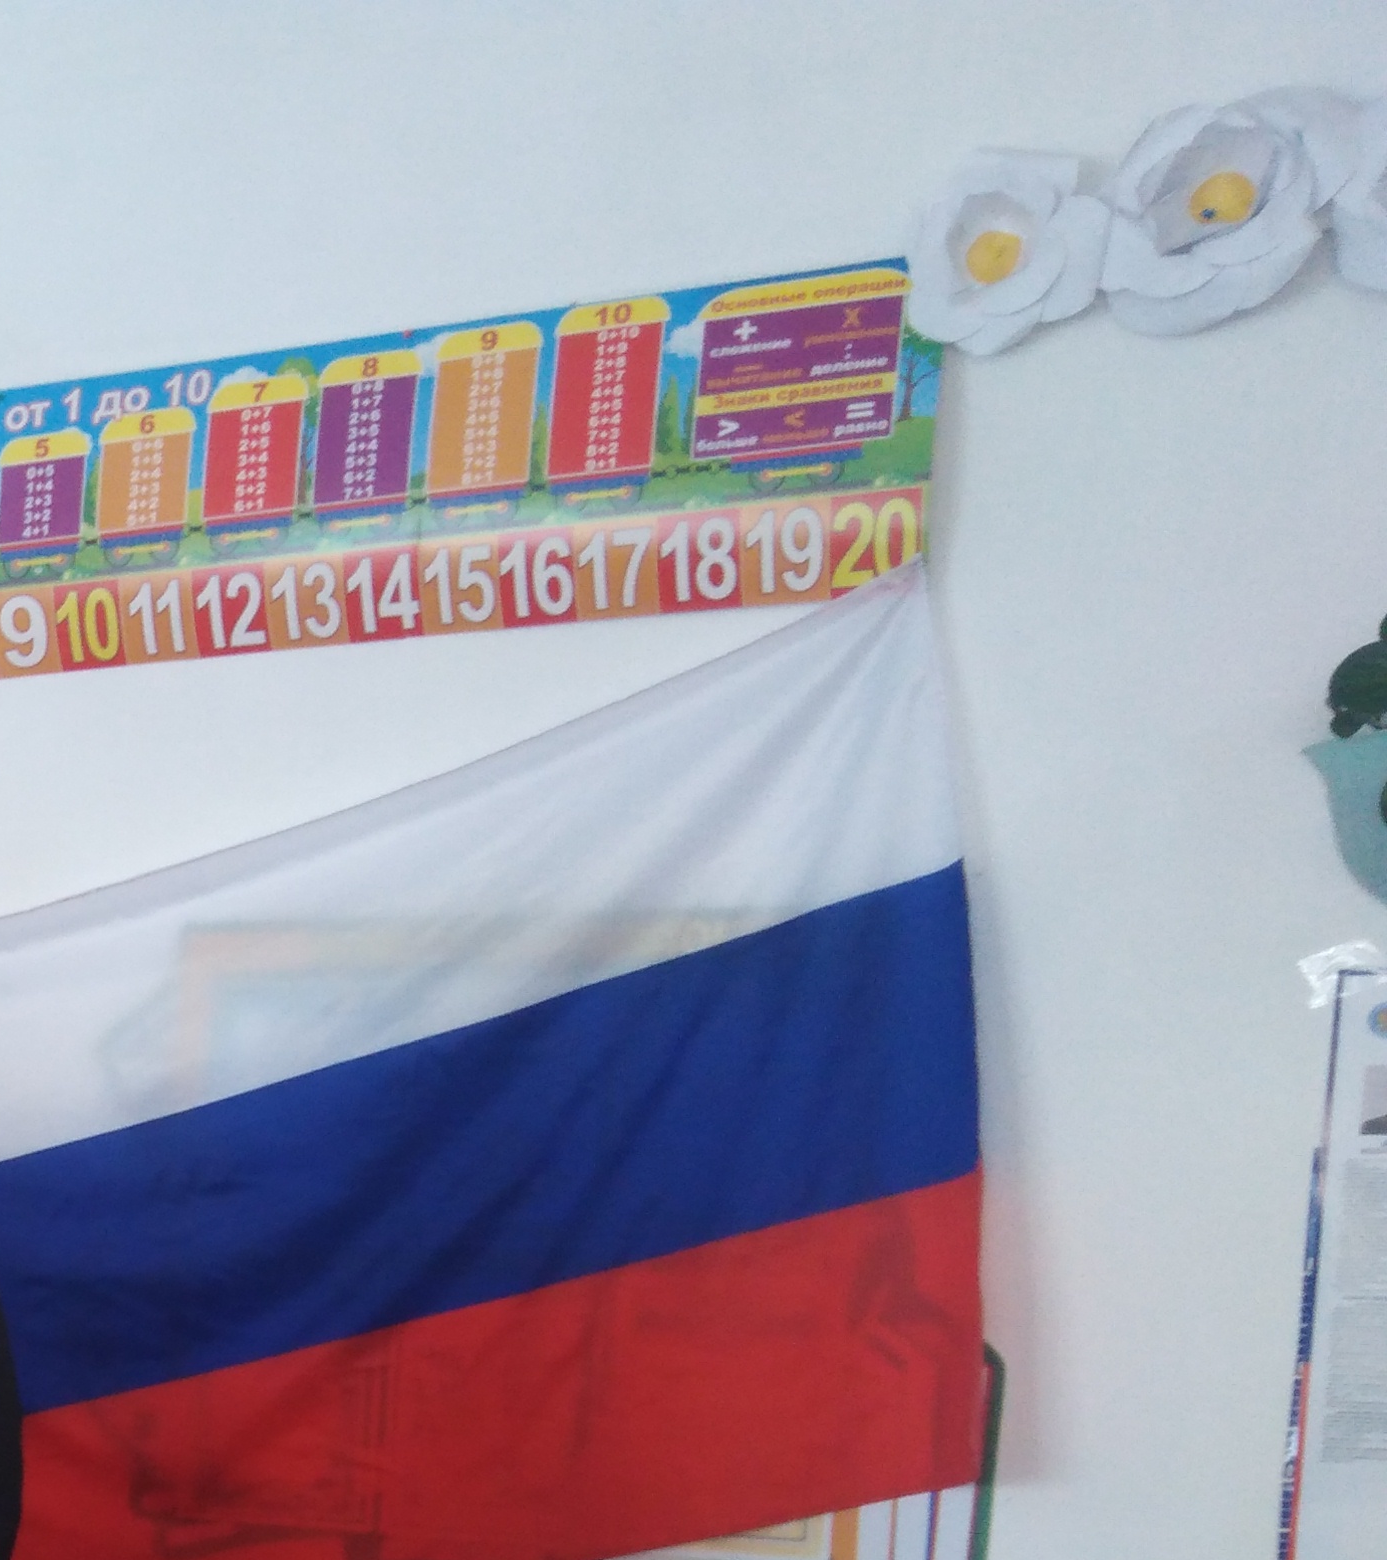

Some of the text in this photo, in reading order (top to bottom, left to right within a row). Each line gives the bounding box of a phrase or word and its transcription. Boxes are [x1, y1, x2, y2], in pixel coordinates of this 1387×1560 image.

[711, 278, 907, 313] Основные операции
[596, 304, 632, 326] 10
[481, 330, 498, 350] 9
[709, 338, 793, 358] сложение
[362, 357, 379, 377] 8
[3, 400, 52, 434] от
[60, 389, 82, 423] 1
[90, 382, 148, 422] до
[164, 369, 212, 413] 10
[253, 382, 269, 403] 7
[714, 378, 884, 410] Знаки сравнения
[140, 415, 155, 434] 6
[35, 439, 50, 458] 5
[346, 440, 378, 455] 4+4
[343, 484, 374, 501] 7+1
[0, 595, 49, 667] 9
[56, 587, 122, 664] 10
[127, 581, 186, 657] 11
[195, 573, 266, 650] 12
[270, 563, 341, 642] 13
[345, 554, 421, 635] 14
[423, 545, 496, 625] 15
[500, 537, 576, 618] 16
[577, 526, 653, 611] 17
[658, 515, 738, 603] 18
[744, 506, 824, 594] 19
[834, 498, 917, 587] 20
